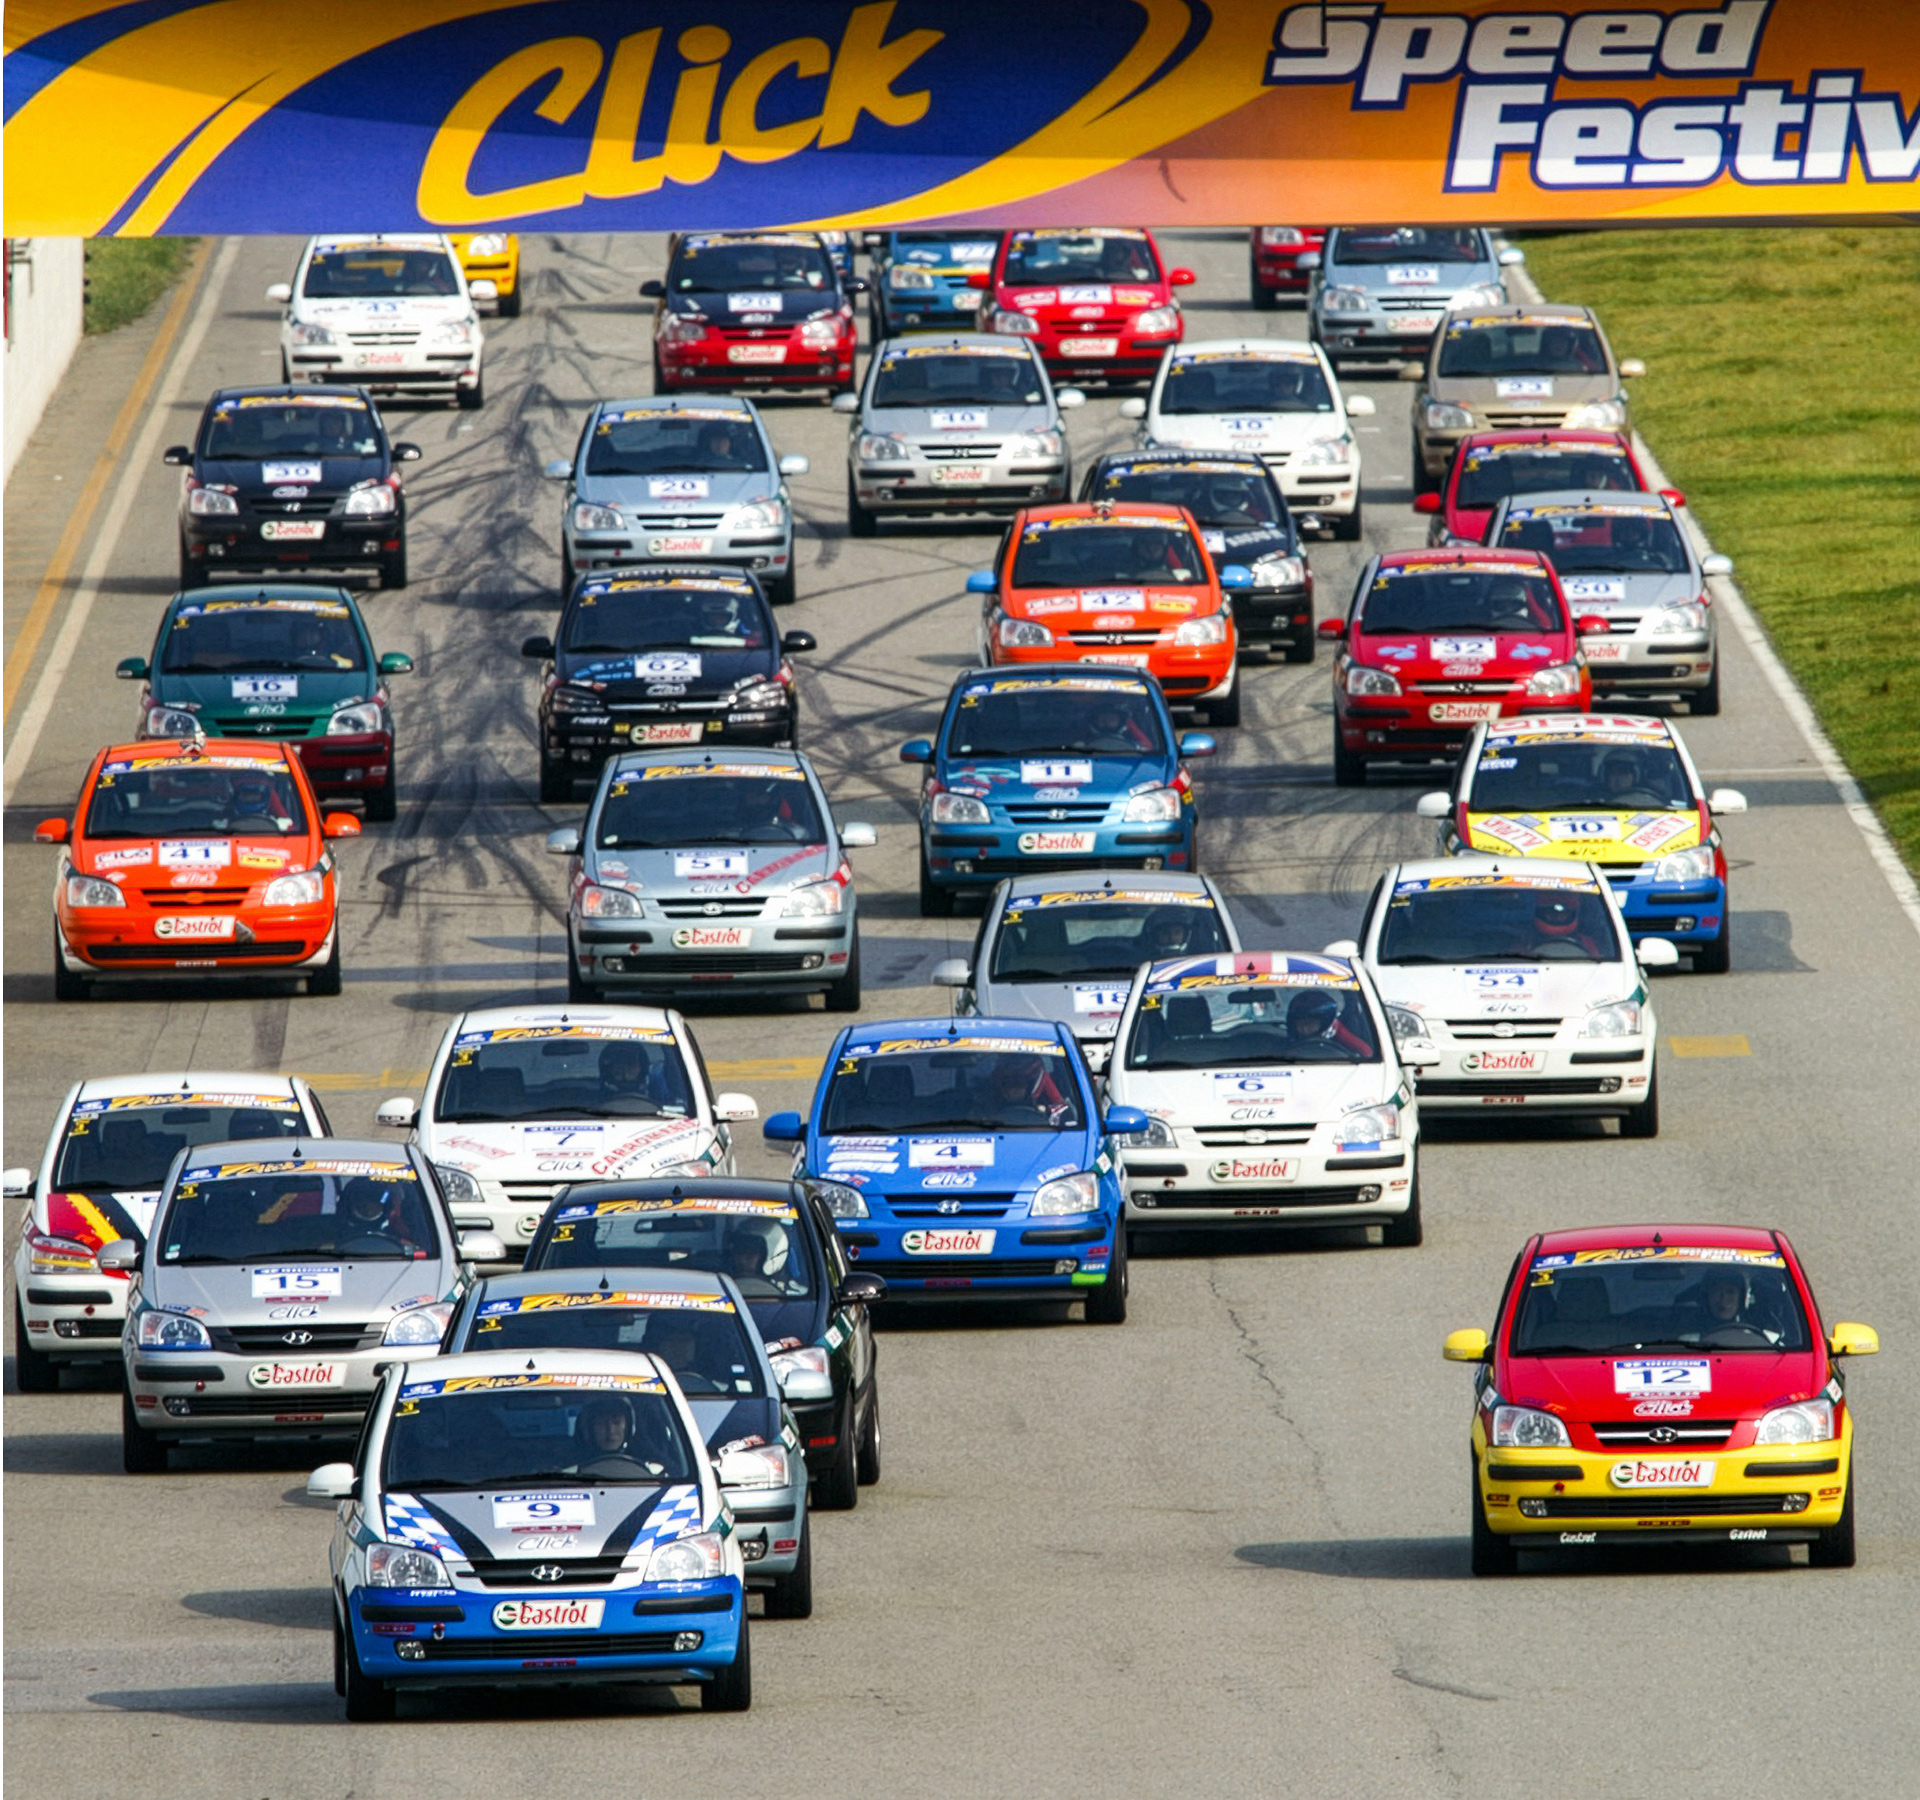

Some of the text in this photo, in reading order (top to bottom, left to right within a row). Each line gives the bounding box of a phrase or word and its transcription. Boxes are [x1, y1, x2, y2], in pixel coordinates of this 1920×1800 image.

[1262, 0, 1770, 110] Speed
[417, 0, 947, 226] Click
[1442, 69, 1920, 193] Festiv
[648, 660, 691, 672] 62
[246, 680, 283, 692] 16
[1445, 703, 1489, 719] Castrol
[647, 725, 692, 740] Castrol
[1043, 766, 1071, 776] 11
[1562, 821, 1605, 834] 10
[1036, 834, 1084, 850] Castrol
[170, 847, 212, 859] 41
[691, 858, 733, 870] 51
[174, 918, 223, 935] Castrol
[692, 928, 741, 945] Castrol
[1478, 975, 1525, 987] 54
[1481, 1052, 1535, 1069] Castrol
[1237, 1078, 1265, 1091] 6
[553, 1131, 576, 1145] 7
[935, 1145, 962, 1158] 4
[1232, 1160, 1288, 1179] Castrol
[923, 1232, 982, 1250] Castrol
[270, 1275, 320, 1289] 15
[272, 1365, 333, 1384] Castrol
[1631, 1368, 1692, 1384] 12
[1635, 1461, 1701, 1483] Castrol
[527, 1502, 560, 1518] 9
[519, 1604, 589, 1626] Castrol
